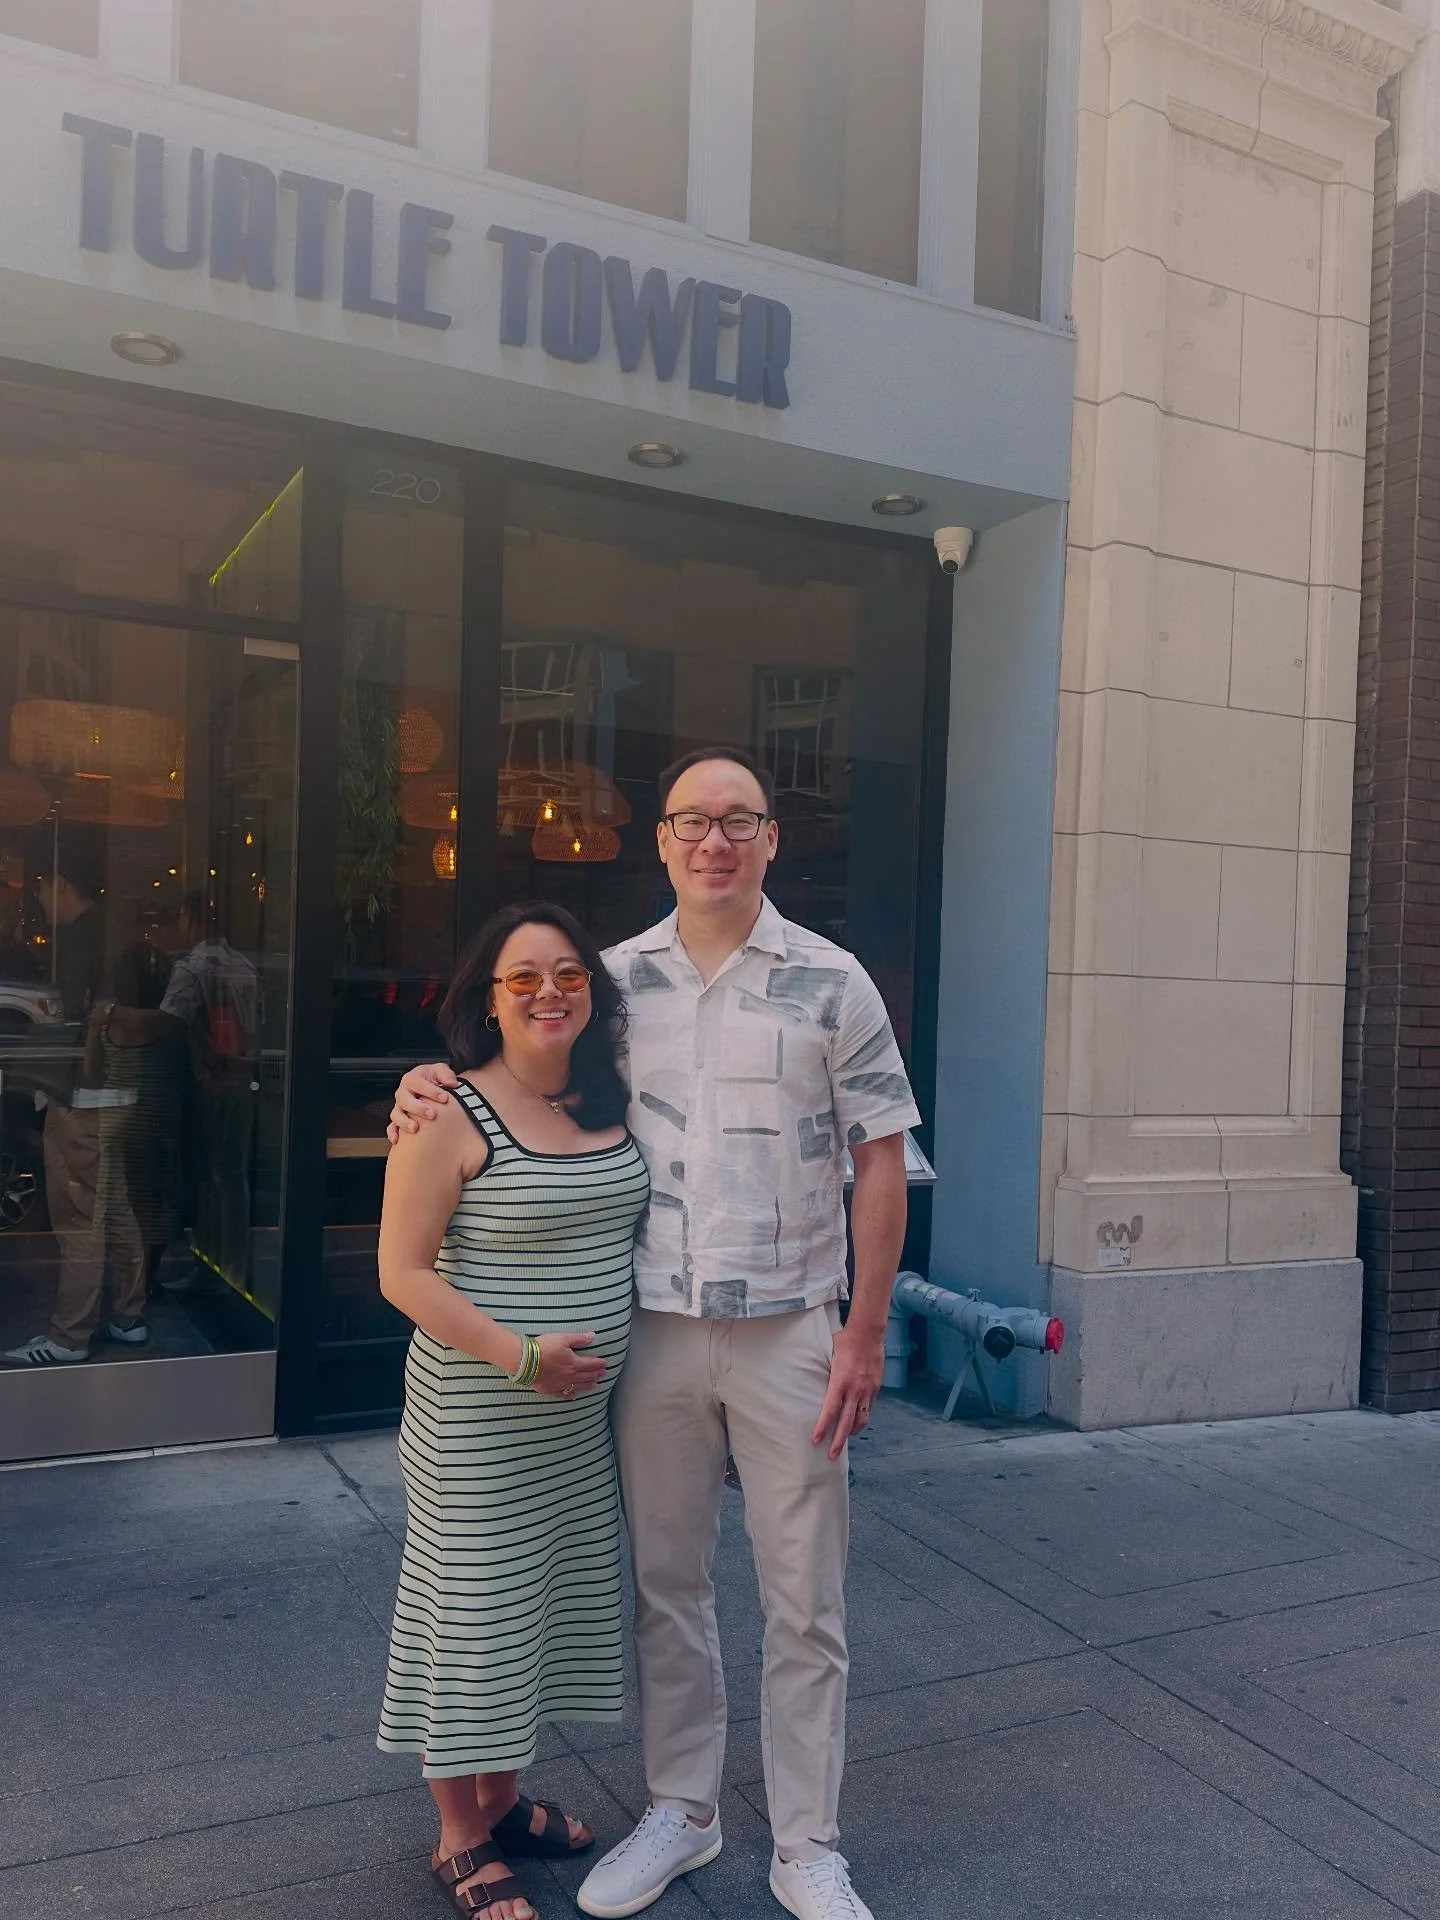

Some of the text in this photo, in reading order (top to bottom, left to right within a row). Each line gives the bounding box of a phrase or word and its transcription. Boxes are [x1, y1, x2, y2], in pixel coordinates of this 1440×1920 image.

[62, 112, 792, 410] TURTLE TOWER
[369, 468, 441, 504] 220
